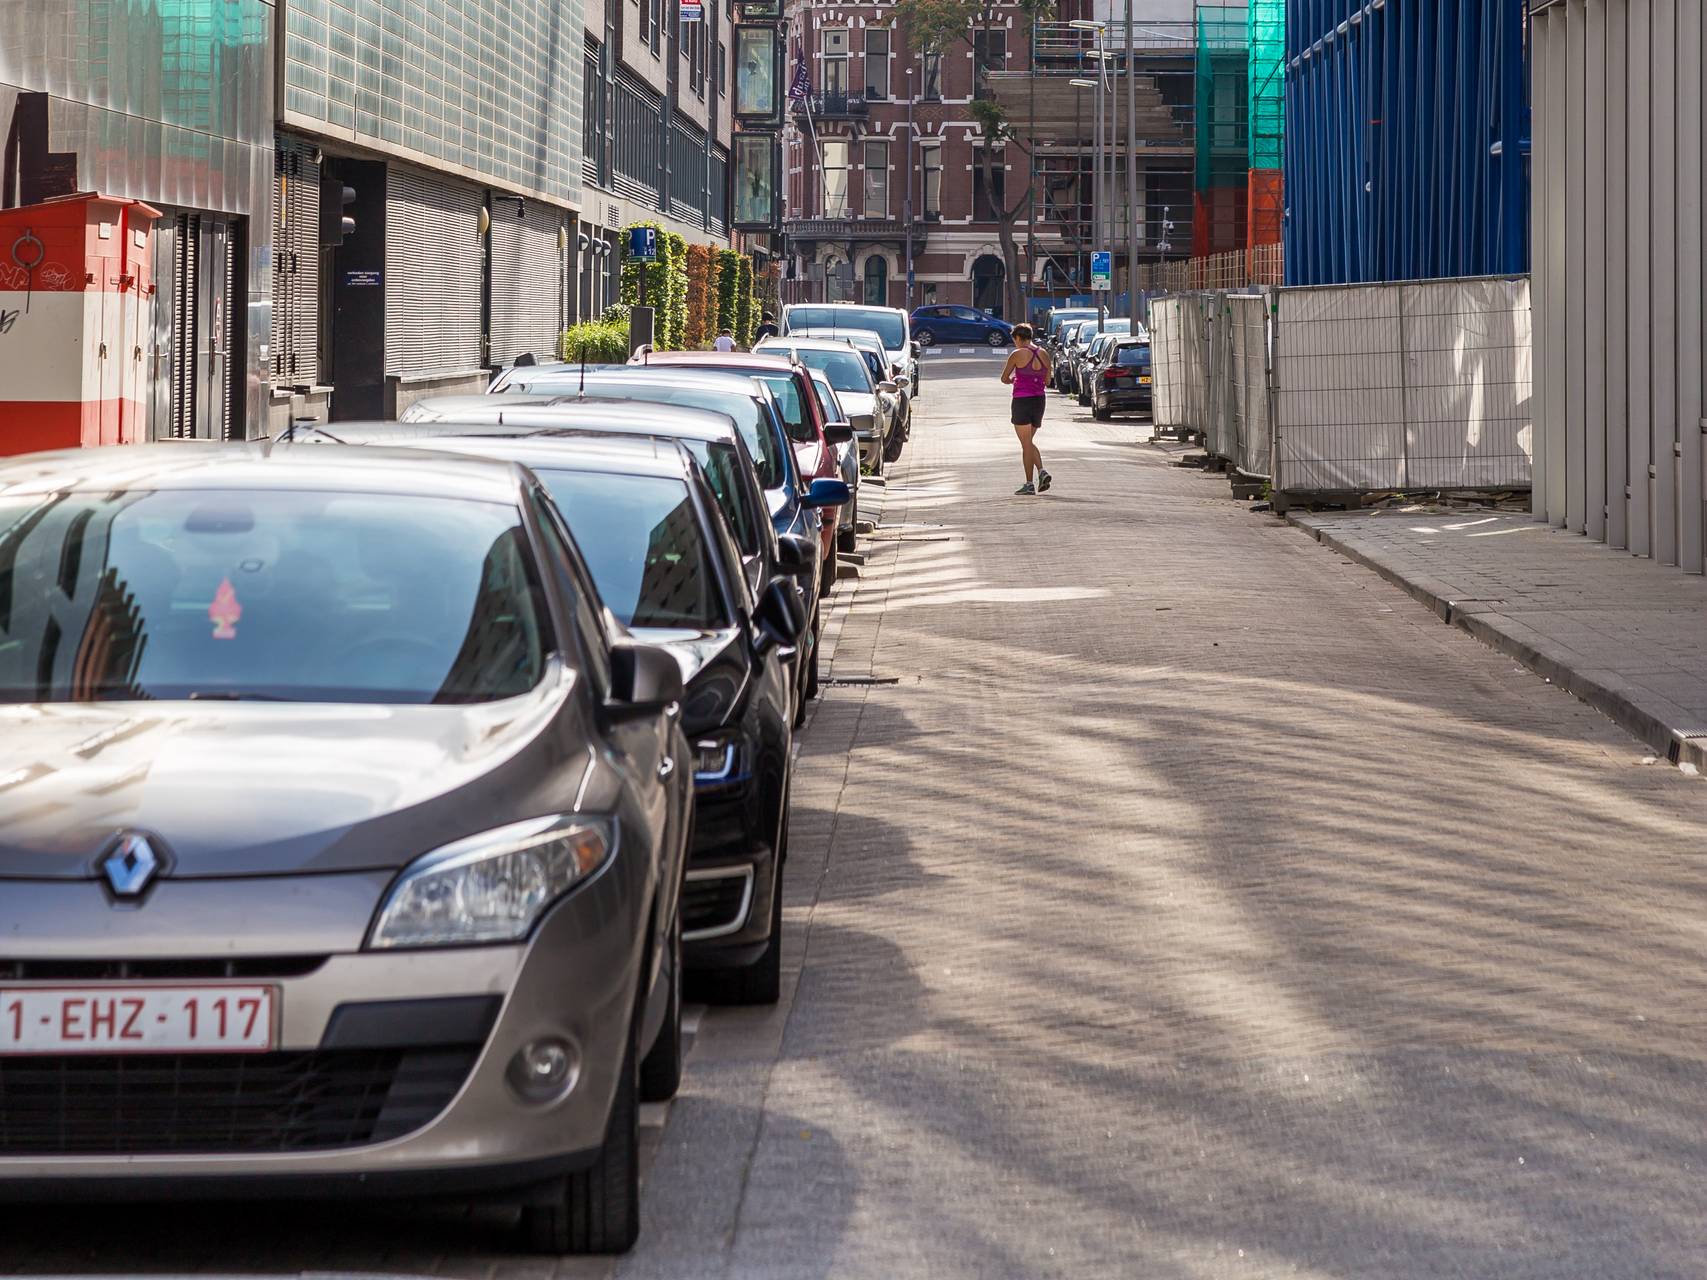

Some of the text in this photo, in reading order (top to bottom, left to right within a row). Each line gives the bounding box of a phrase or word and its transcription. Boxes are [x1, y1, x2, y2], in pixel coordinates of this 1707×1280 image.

[646, 229, 655, 245] P
[1093, 253, 1100, 263] P
[7, 998, 262, 1041] 1-EHZ-117
